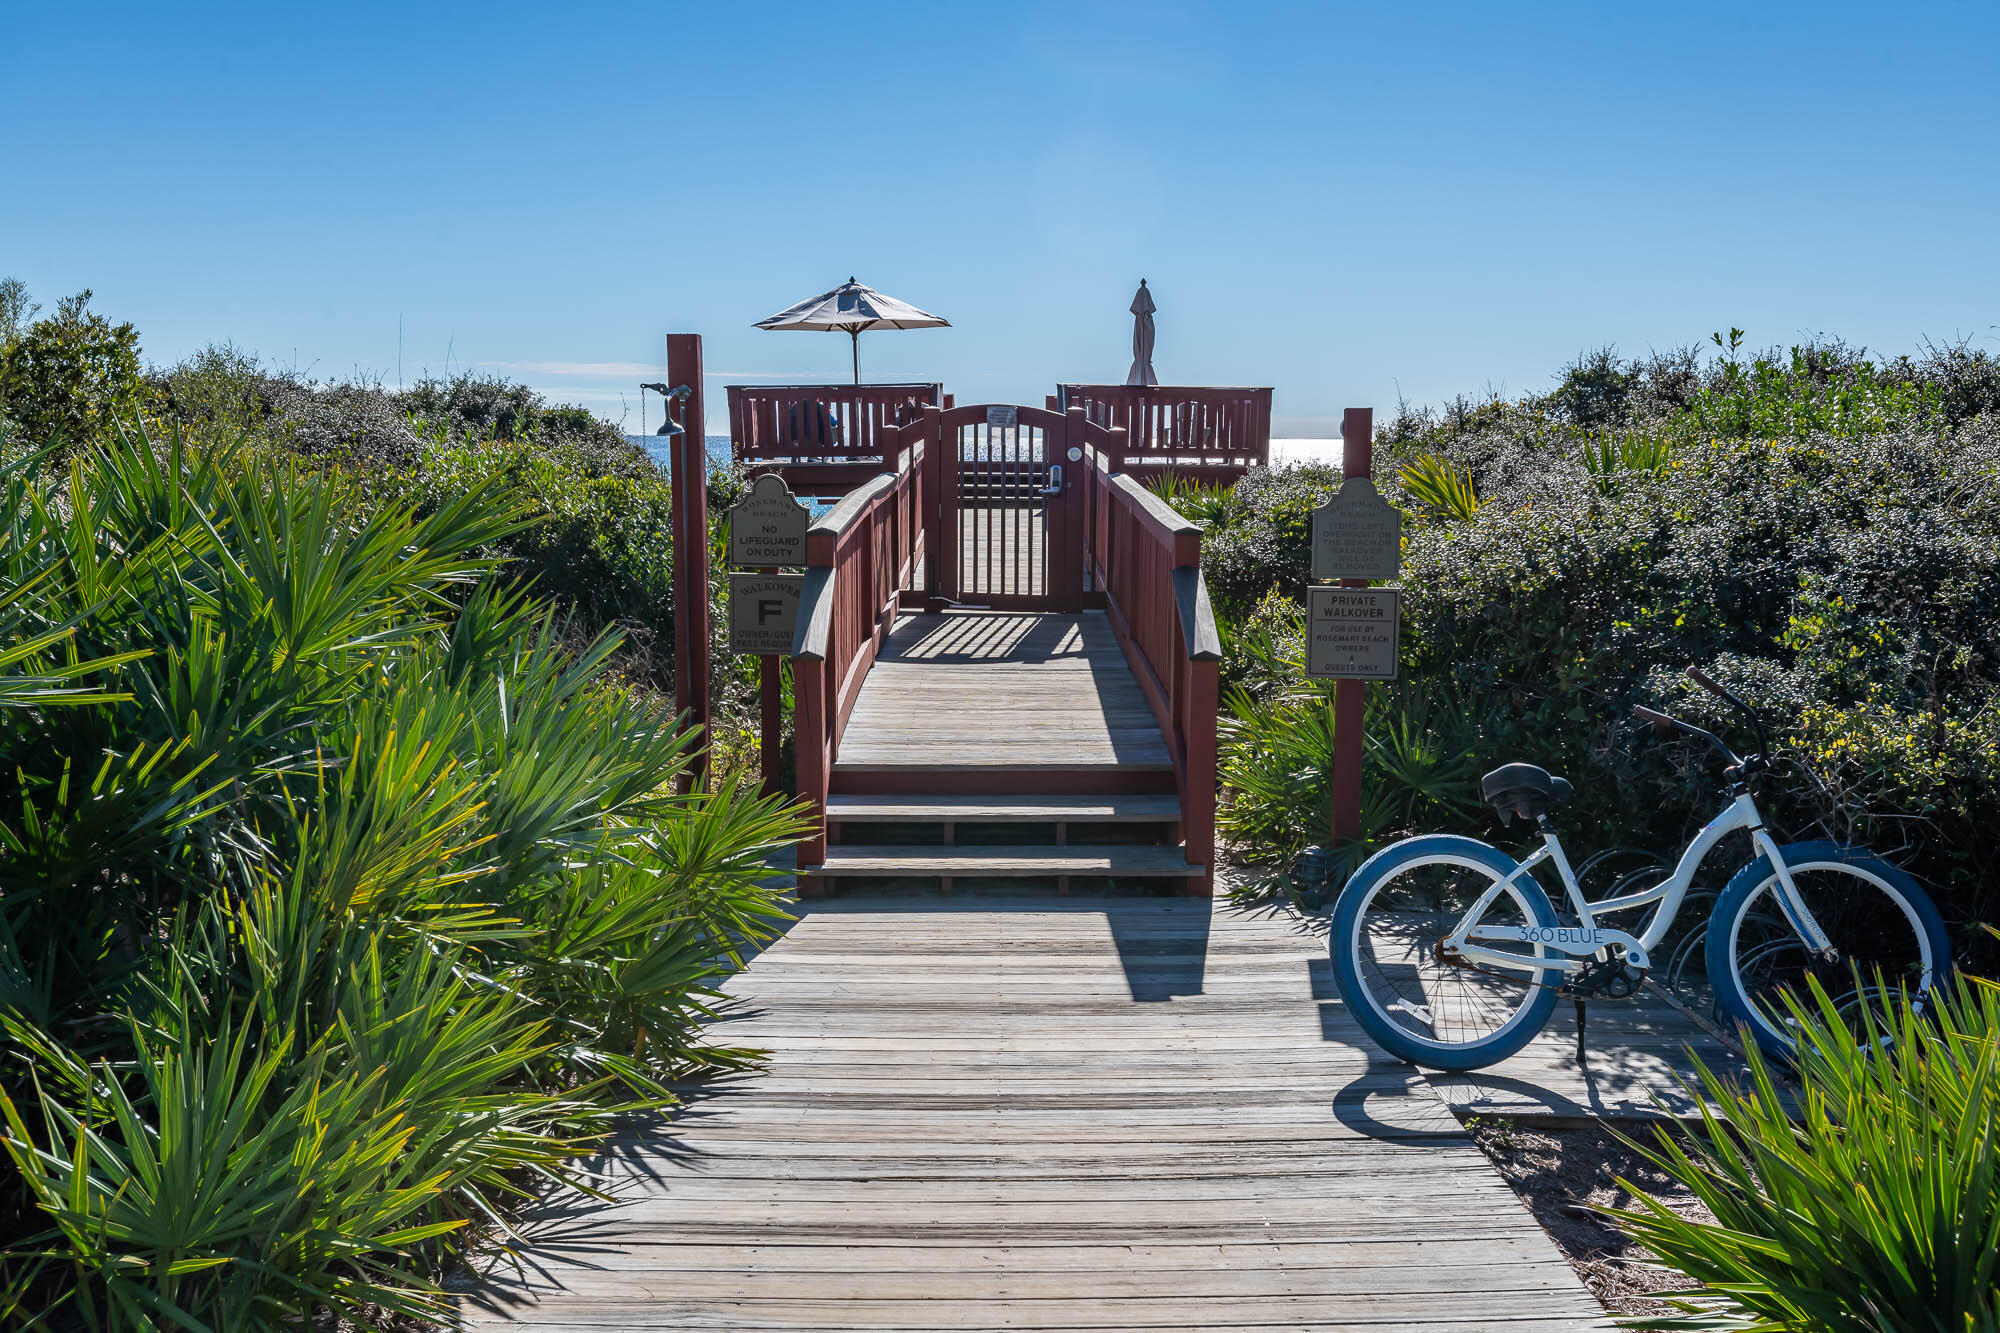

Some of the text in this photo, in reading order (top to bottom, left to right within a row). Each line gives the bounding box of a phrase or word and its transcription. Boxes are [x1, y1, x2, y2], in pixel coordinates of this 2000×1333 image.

[761, 525, 778, 535] NO
[739, 536, 800, 546] LIFEGUARD
[746, 547, 793, 557] ON DUTY
[1331, 596, 1377, 606] PRIVATE
[758, 599, 783, 626] F
[1324, 607, 1384, 618] WALKOVER
[1330, 625, 1375, 633] FOR USE BY
[1324, 663, 1379, 672] GUESTS ONLY
[1518, 926, 1604, 944] 360 BLUE
